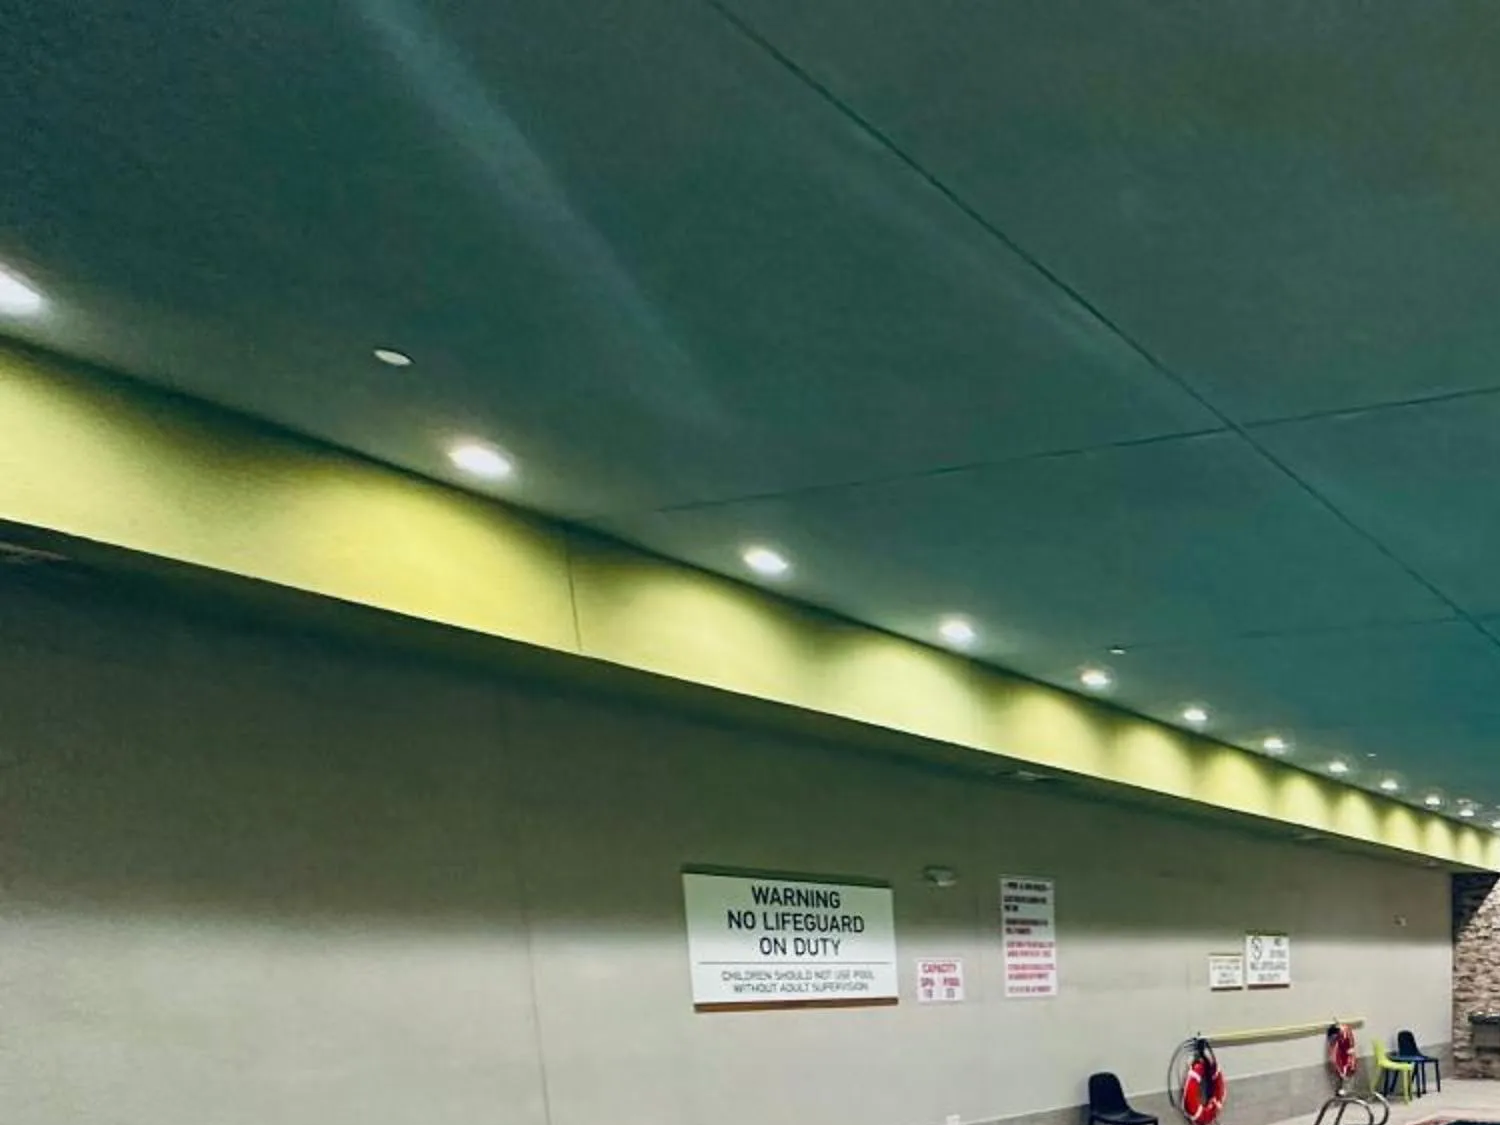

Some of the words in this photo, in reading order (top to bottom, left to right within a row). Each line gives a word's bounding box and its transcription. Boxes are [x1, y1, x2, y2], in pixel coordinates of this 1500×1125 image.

[751, 885, 841, 909] WARNING
[727, 909, 756, 930] NO
[762, 911, 865, 933] LIFEGUARD
[759, 937, 787, 956] ON
[793, 937, 841, 956] DUTY
[733, 982, 777, 993] WITHOUT
[780, 982, 810, 993] ADULT
